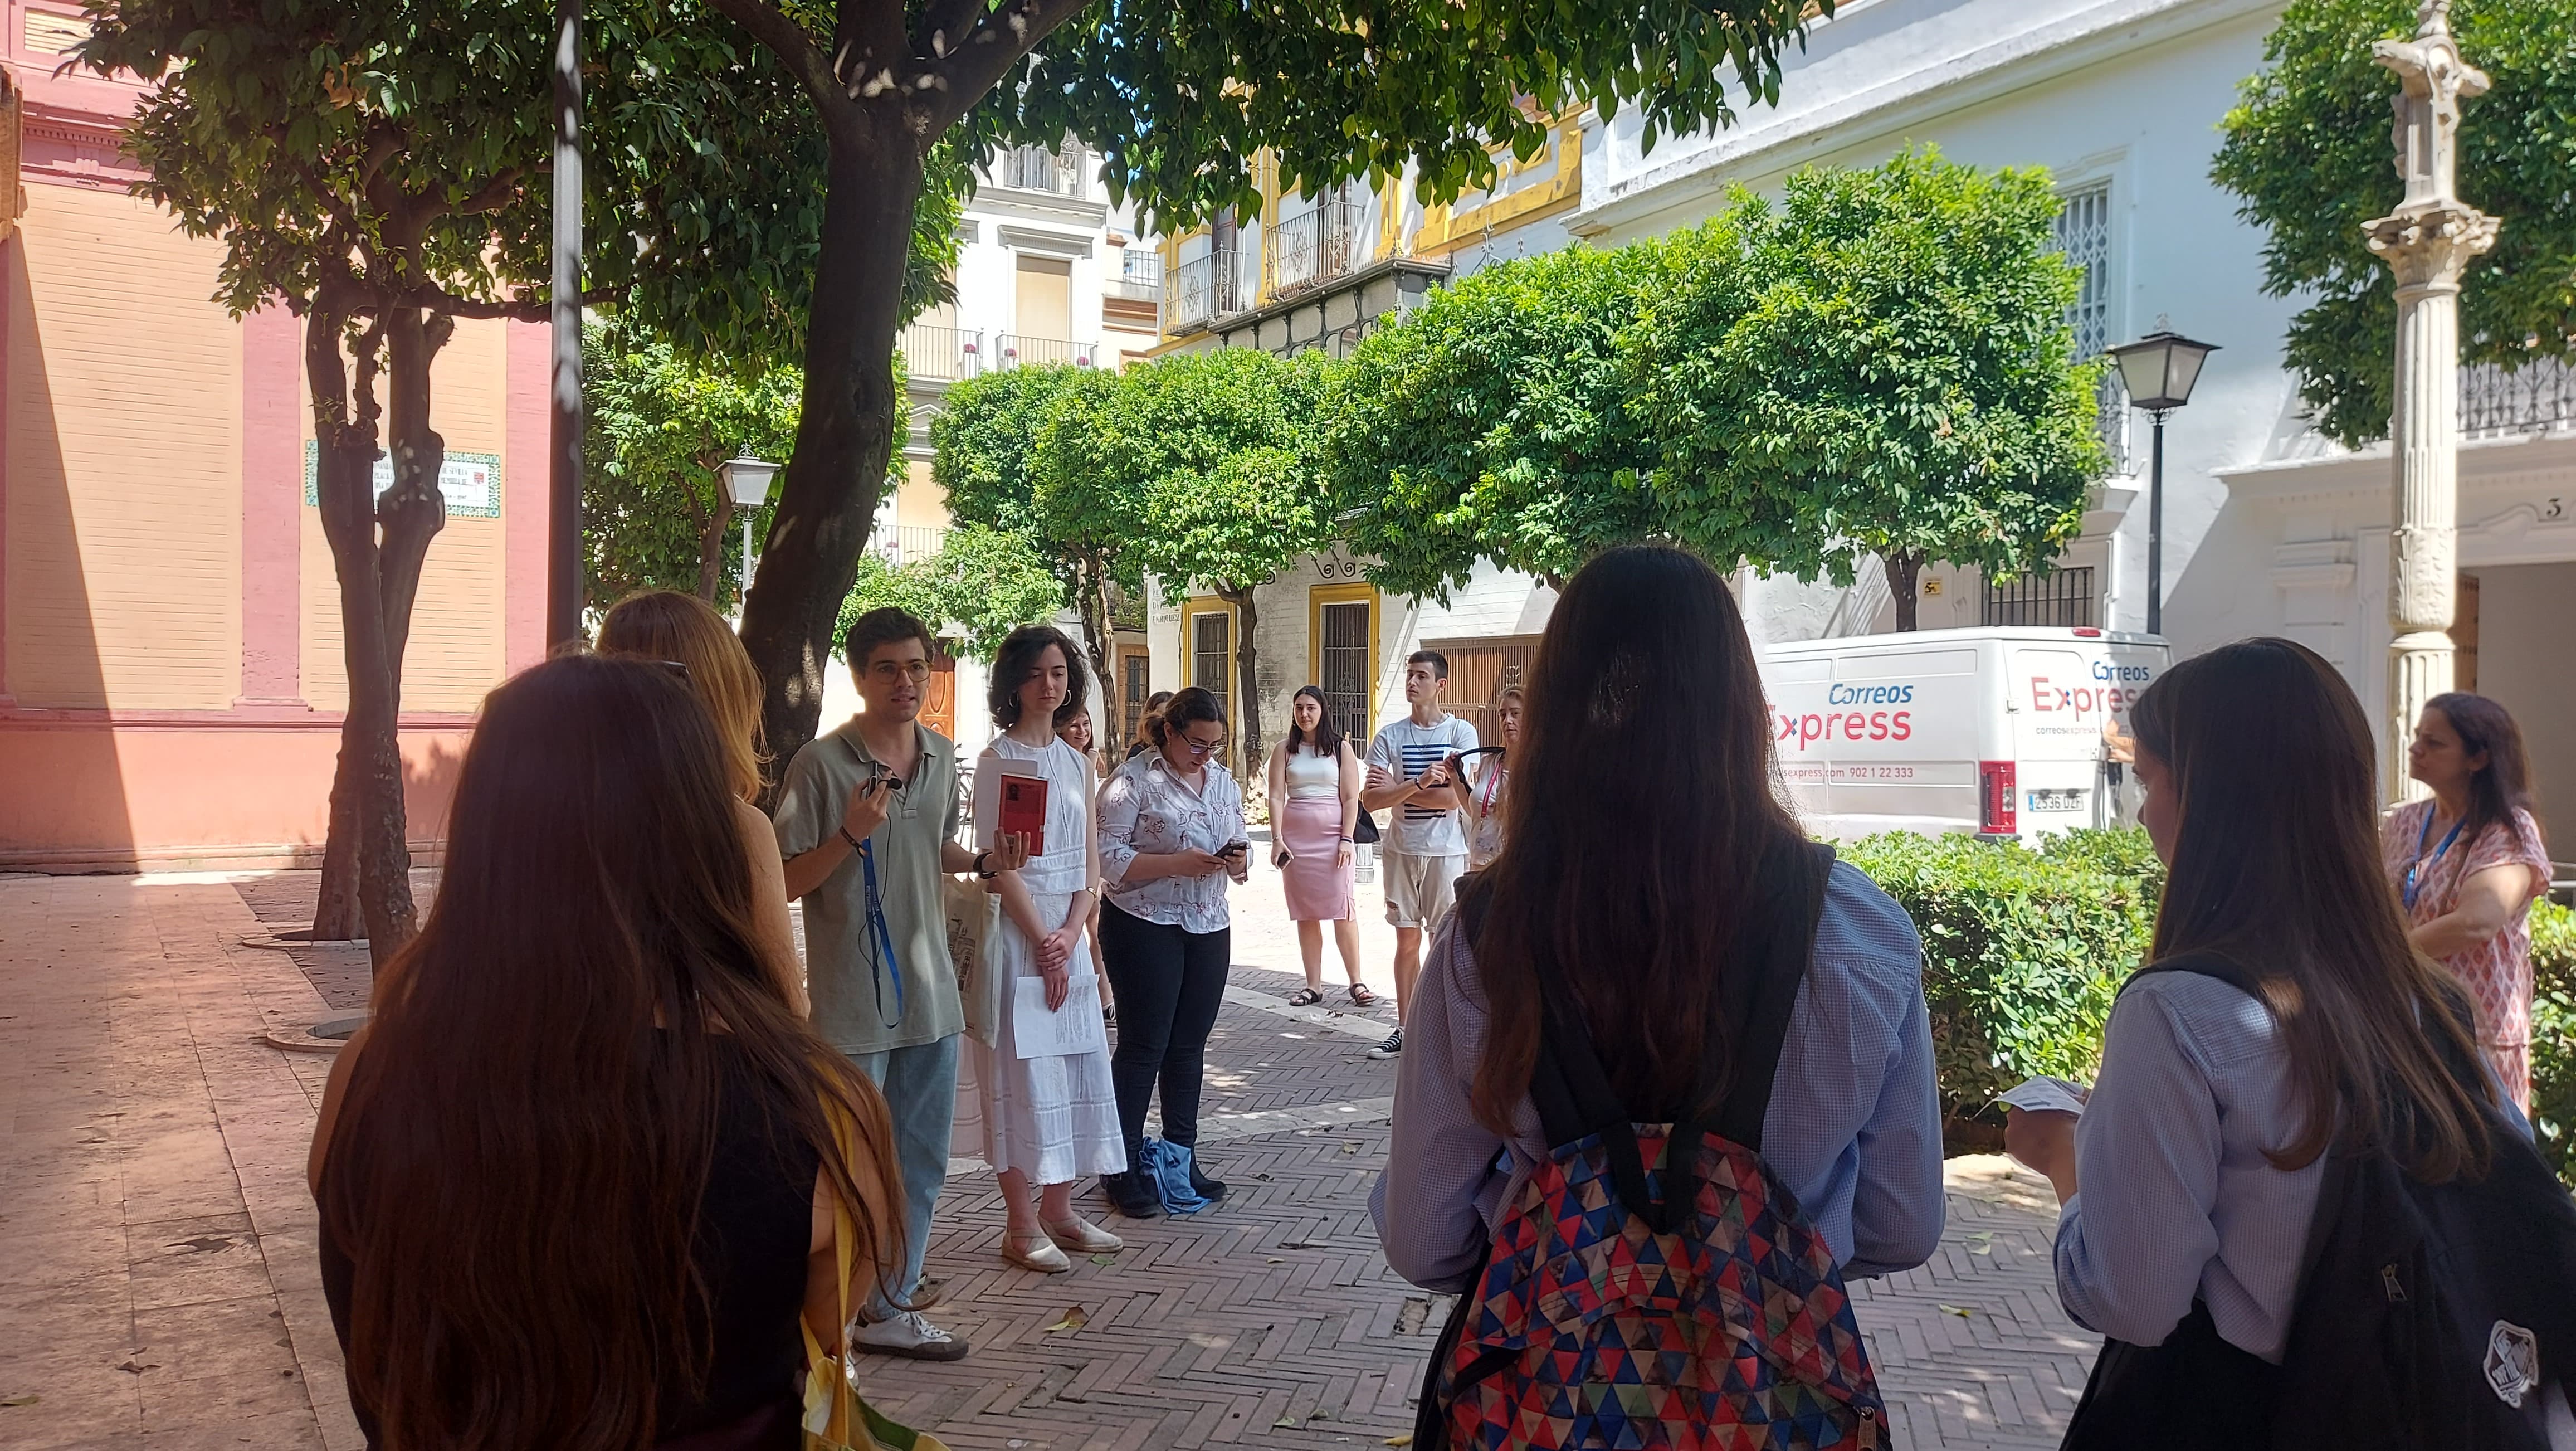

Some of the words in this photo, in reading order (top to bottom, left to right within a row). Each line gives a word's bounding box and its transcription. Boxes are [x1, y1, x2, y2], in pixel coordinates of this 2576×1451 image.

[2546, 498, 2561, 517] 3
[1152, 613, 1180, 623] ENRIQUEZ
[2092, 661, 2149, 681] Correos
[1829, 683, 1914, 705] Correos
[2031, 676, 2141, 722] Expres
[1767, 704, 1911, 751] xpress
[1783, 767, 1845, 779] sexpress.com
[1850, 767, 1867, 777] 902
[1871, 768, 1875, 777] 1
[1879, 767, 1891, 777] 22
[1895, 767, 1913, 777] 333
